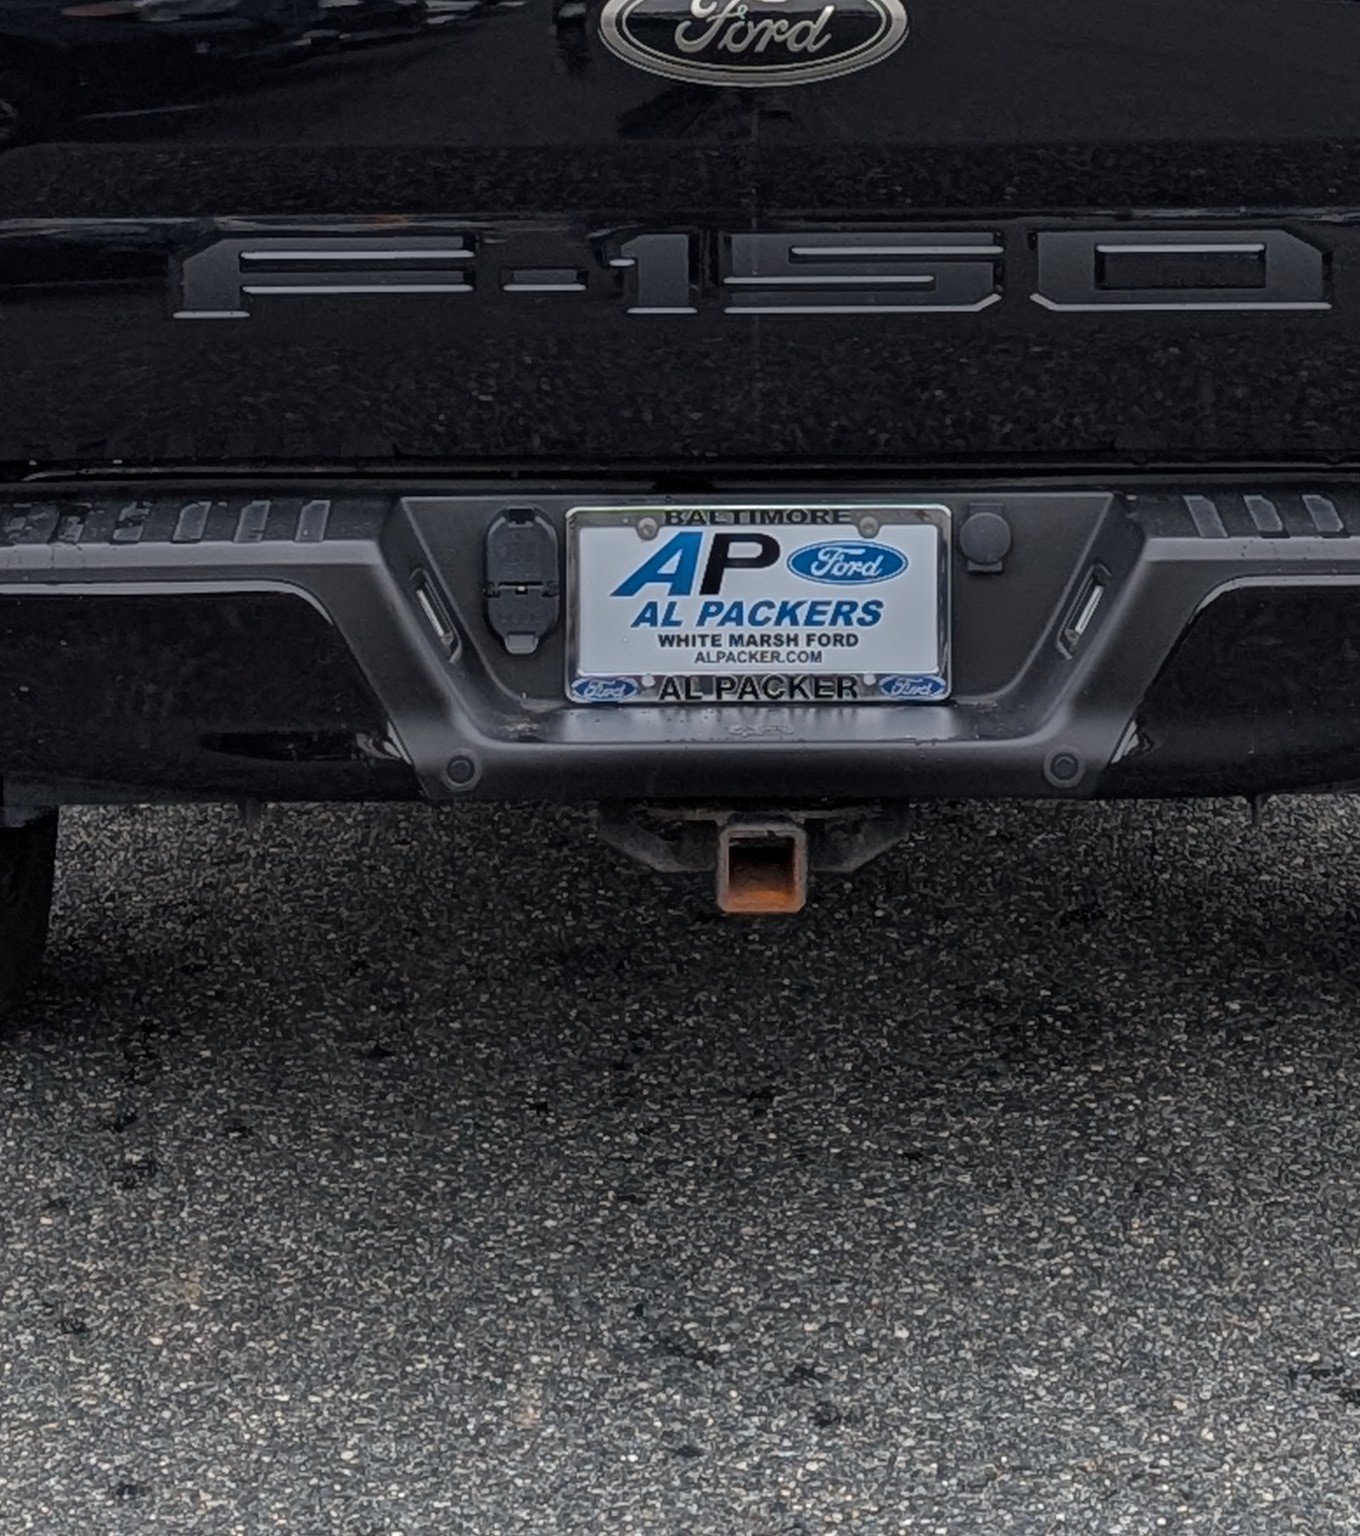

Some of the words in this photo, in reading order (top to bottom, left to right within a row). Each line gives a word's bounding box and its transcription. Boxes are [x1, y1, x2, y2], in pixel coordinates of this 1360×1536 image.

[172, 231, 1333, 318] F-150
[664, 509, 852, 525] BALTIMORE
[610, 531, 781, 597] AP
[810, 547, 883, 578] Ford
[630, 601, 682, 628] AL
[697, 600, 885, 628] PACKERS
[658, 634, 722, 647] WHITE
[729, 634, 798, 647] MARSH
[806, 633, 859, 647] FORD
[694, 651, 822, 664] ALPACKER.COM
[659, 676, 703, 701] AL
[715, 675, 859, 701] PACKER
